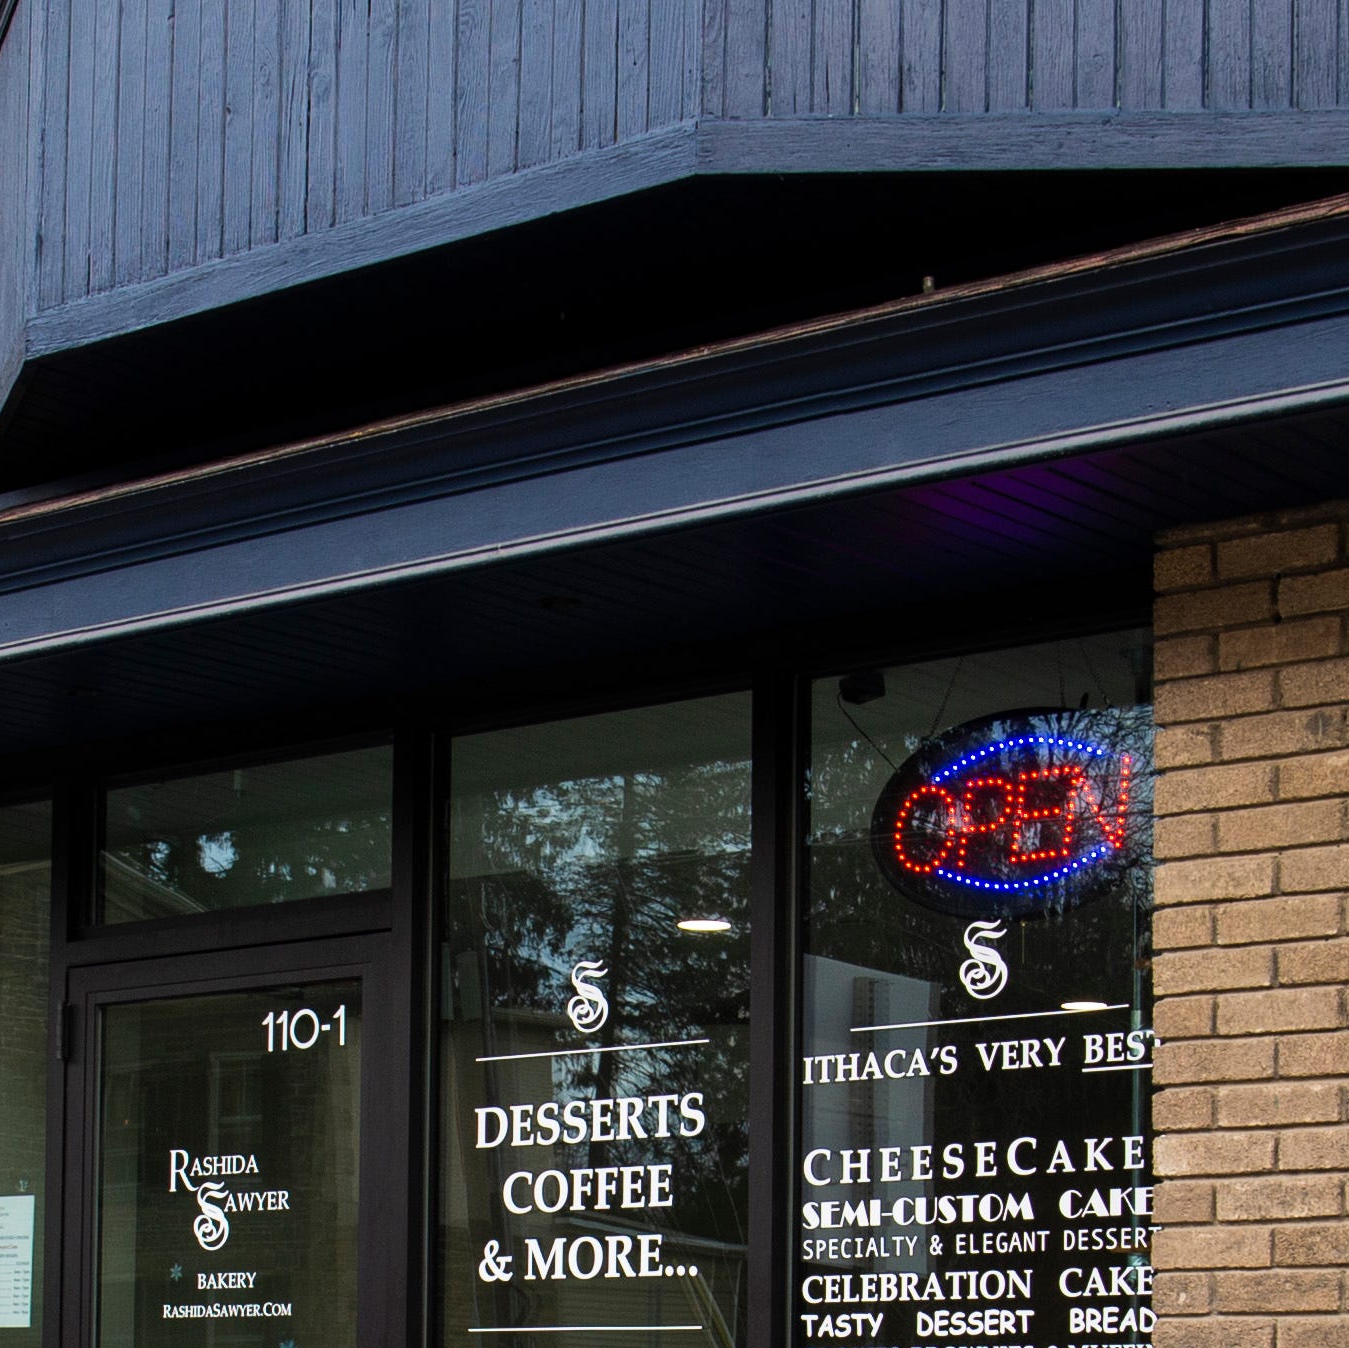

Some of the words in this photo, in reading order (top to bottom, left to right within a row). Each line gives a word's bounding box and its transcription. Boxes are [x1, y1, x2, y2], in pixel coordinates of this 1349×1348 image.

[894, 755, 1131, 872] OPEN
[262, 1005, 346, 1052] 110-1
[803, 1045, 958, 1085] ITHACA'S
[975, 1037, 1067, 1072] VERY
[475, 1093, 706, 1149] DESSERTS
[169, 1150, 259, 1193] RASHIDA
[803, 1136, 1145, 1187] CHEESECAKE
[502, 1164, 674, 1215] COFFEE
[802, 1193, 1035, 1230] SEMI-CUSTOM
[1059, 1187, 1154, 1220] CAKE
[193, 1181, 290, 1251] SAWYER
[479, 1239, 513, 1283] &
[525, 1234, 698, 1281] MORE...
[803, 1235, 918, 1261] SPECIALTY
[930, 1234, 943, 1256] &
[956, 1231, 1050, 1255] ELEGANT
[197, 1272, 257, 1290] BAKERY
[801, 1270, 1032, 1304] CELEBRATION
[1059, 1266, 1154, 1298] CAKE
[801, 1313, 884, 1338] TASTY
[917, 1309, 1035, 1336] DESSERT
[1070, 1306, 1158, 1334] BREAD
